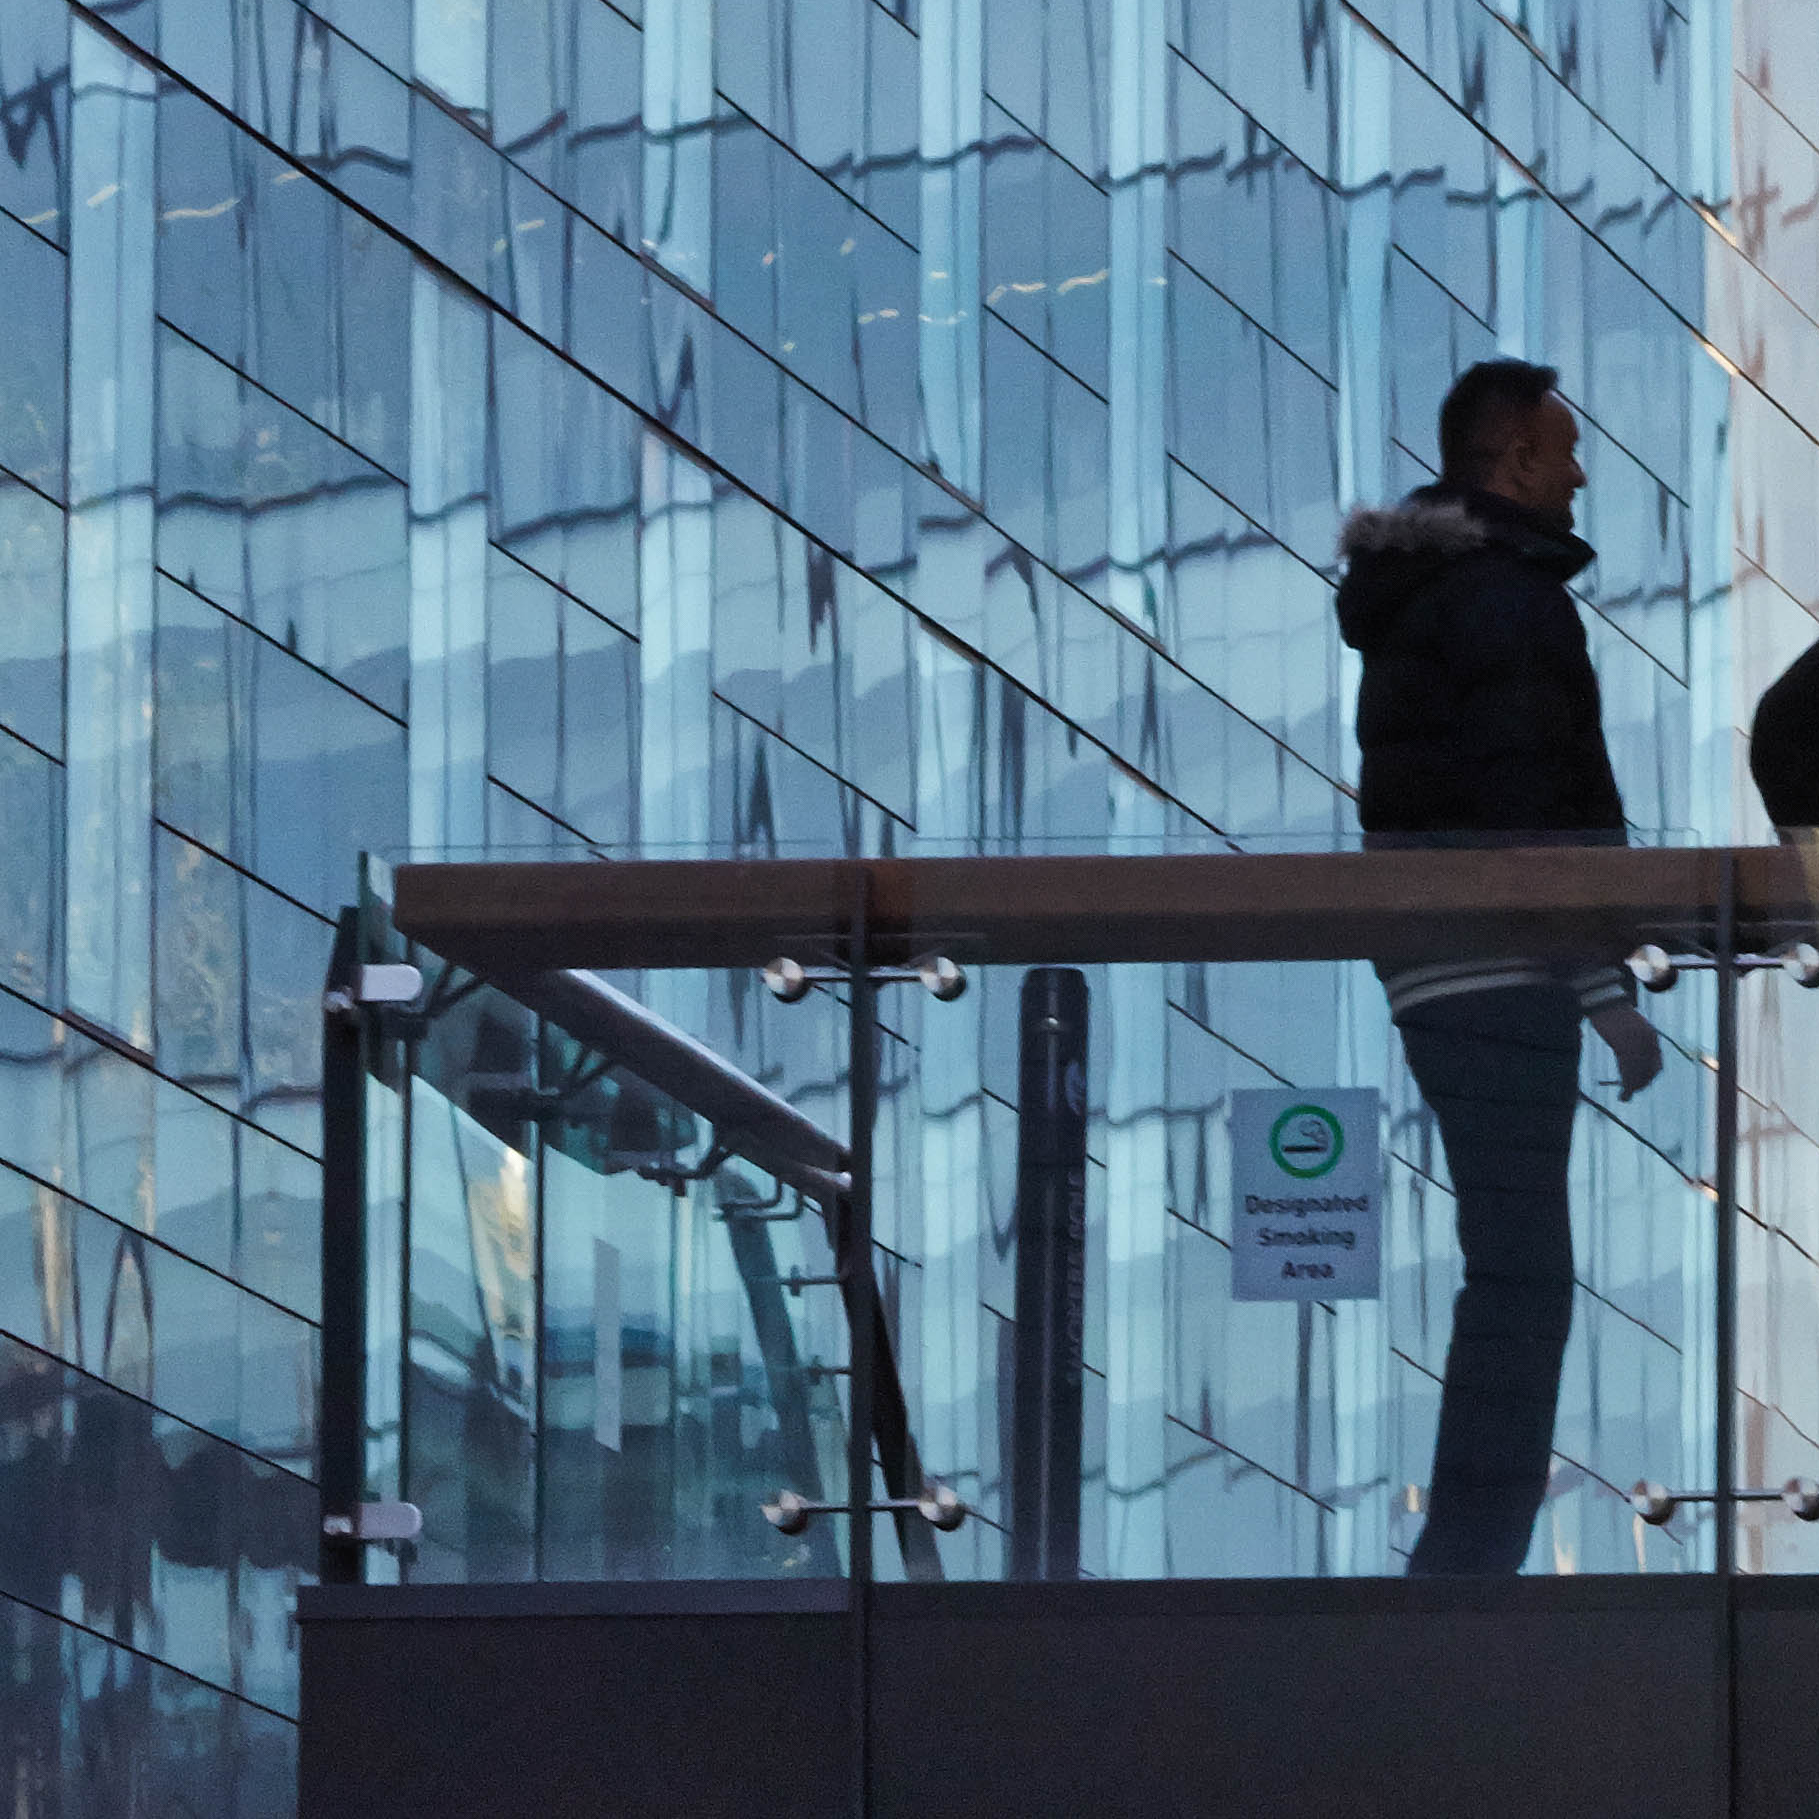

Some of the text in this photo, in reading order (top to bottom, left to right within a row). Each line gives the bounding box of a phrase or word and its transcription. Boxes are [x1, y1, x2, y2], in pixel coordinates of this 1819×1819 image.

[1245, 1194, 1369, 1218] Designated
[1257, 1227, 1356, 1250] Smoking
[1281, 1260, 1335, 1279] Area
